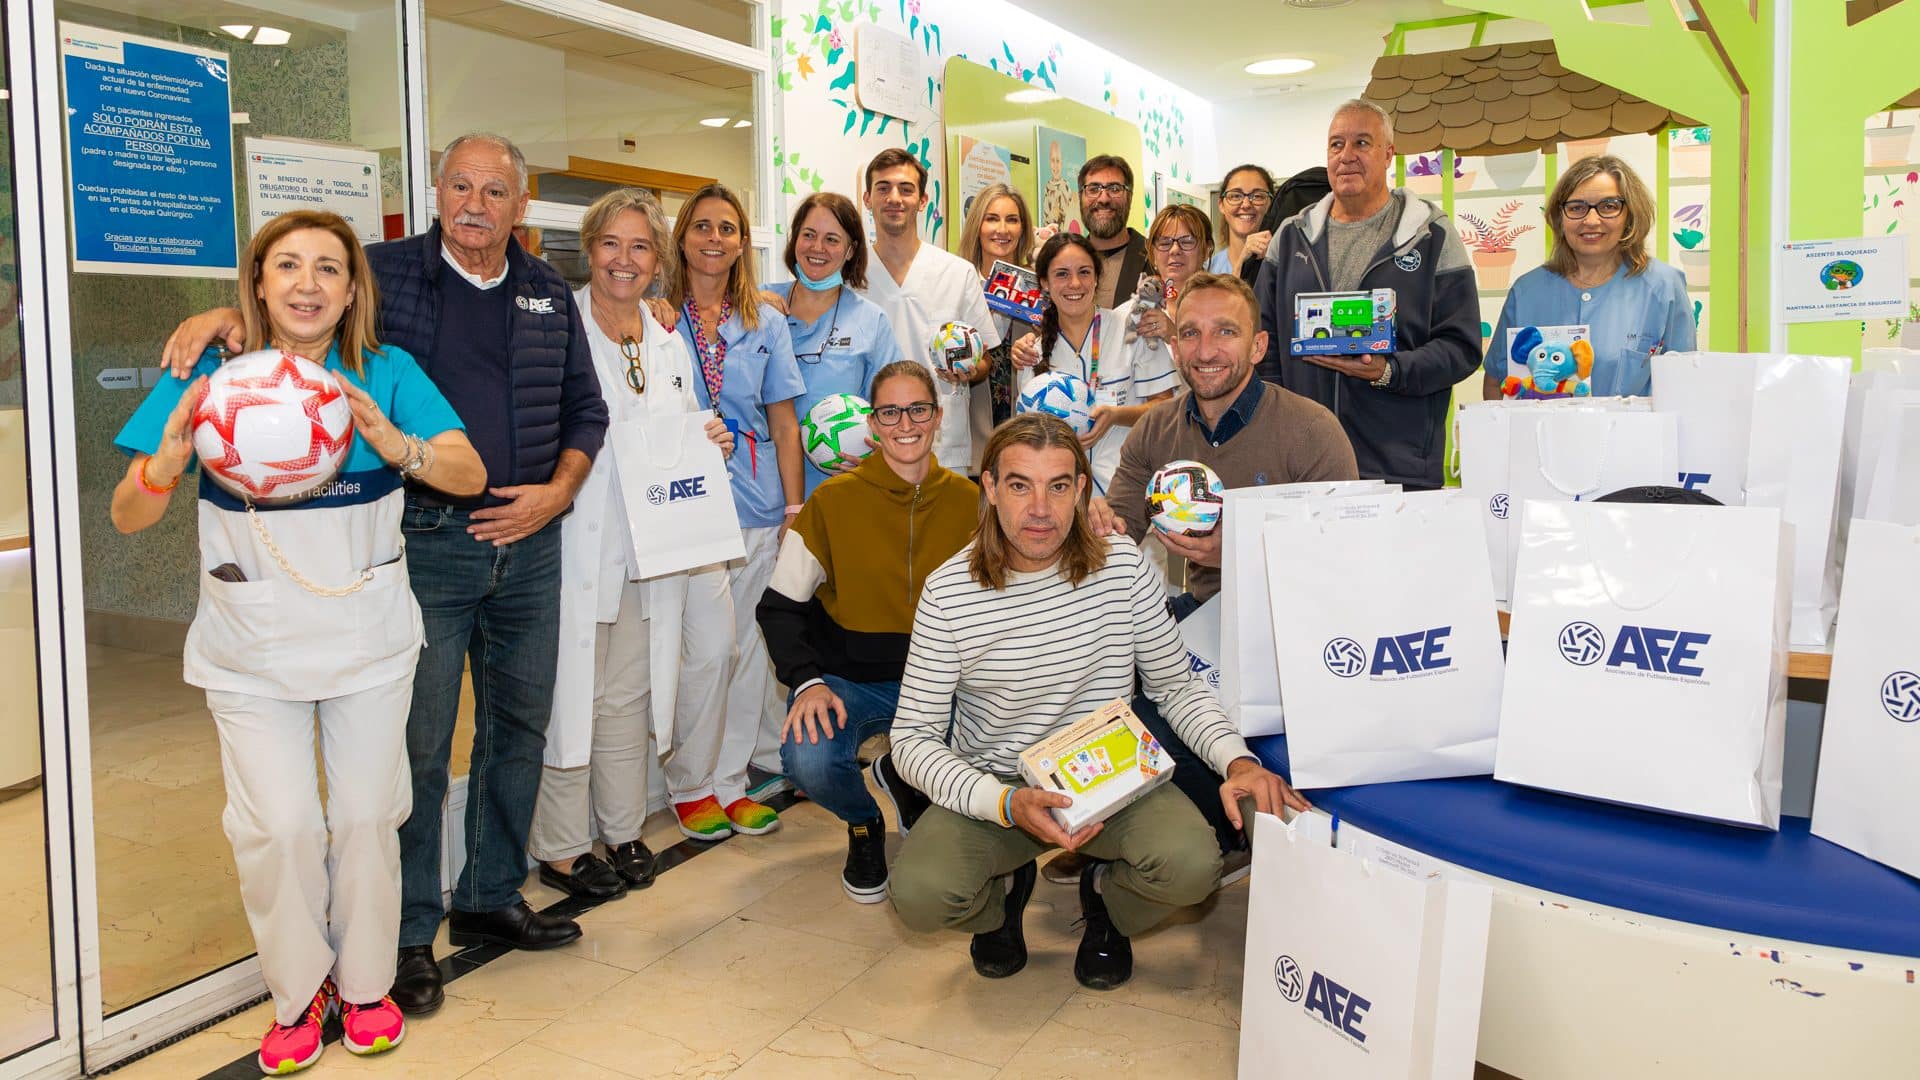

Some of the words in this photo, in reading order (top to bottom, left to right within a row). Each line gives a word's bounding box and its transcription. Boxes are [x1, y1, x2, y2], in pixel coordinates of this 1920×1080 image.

[85, 62, 105, 72] Dada
[117, 67, 149, 79] situación
[151, 73, 203, 87] epidemiológica
[100, 84, 112, 93] por
[115, 85, 121, 93] el
[123, 88, 145, 97] nuevo
[103, 75, 125, 85] actual
[127, 78, 136, 86] de
[138, 79, 144, 87] la
[147, 81, 188, 94] enfermedad
[102, 104, 115, 112] Los
[118, 107, 152, 117] pacientes
[155, 110, 192, 123] ingresados
[93, 113, 121, 124] SOLO
[125, 115, 168, 130] PODRÁN
[170, 124, 202, 135] ESTAR
[84, 124, 164, 141] ACOMPAÑADOS
[168, 135, 187, 145] POR
[190, 138, 210, 148] UNA
[126, 140, 174, 154] PERSONA
[82, 146, 106, 156] (padre
[115, 151, 138, 160] madre
[147, 154, 163, 162] tutor
[165, 156, 181, 166] legal
[190, 160, 217, 169] persona
[113, 160, 150, 171] designada
[153, 164, 164, 172] por
[278, 175, 307, 183] BENEFICIO
[333, 181, 353, 189] TODOS,
[78, 184, 108, 193] Quedan
[111, 186, 148, 197] prohibidas
[178, 192, 187, 200] de
[189, 193, 198, 201] las
[201, 195, 221, 203] visitas
[260, 184, 299, 192] OBLIGATORIO
[335, 189, 368, 198] MASCARILLA
[282, 194, 324, 202] HABITACIONES.
[100, 195, 110, 203] las
[113, 197, 140, 205] Plantas
[154, 200, 205, 211] Hospitalización
[130, 207, 155, 217] Bloque
[105, 233, 132, 242] Gracias
[159, 237, 203, 246] colaboración
[114, 243, 149, 253] Disculpen
[163, 246, 196, 255] molestias
[1837, 249, 1877, 257] BLOQUEADO
[1371, 340, 1389, 350] 4R
[669, 476, 707, 501] AFE
[1370, 626, 1451, 675] AFE
[1606, 625, 1711, 677] AFE
[1305, 971, 1372, 1043] AFE
